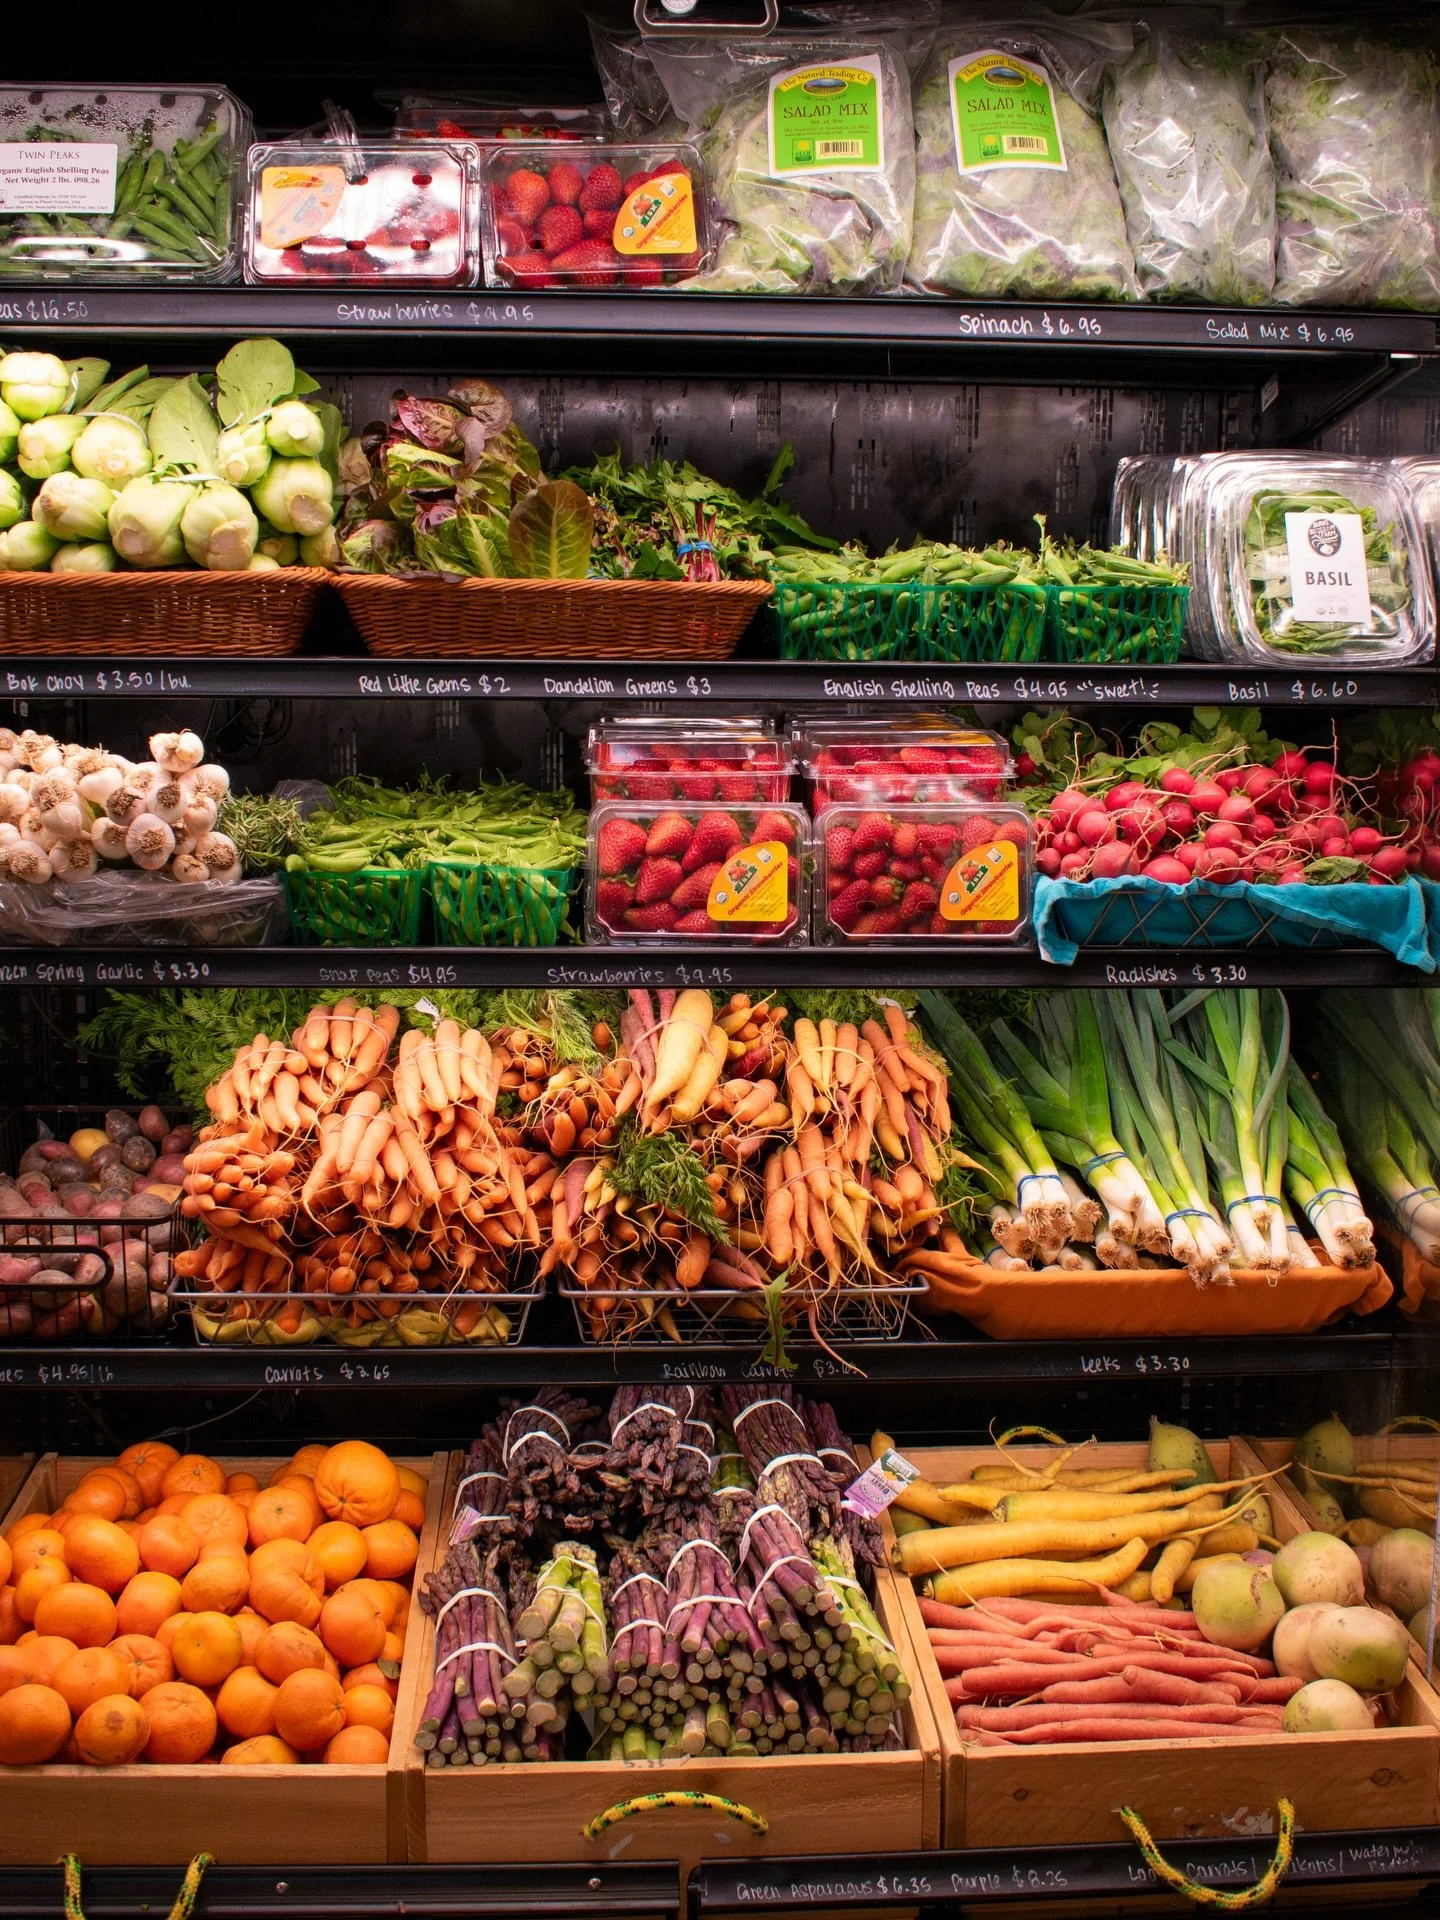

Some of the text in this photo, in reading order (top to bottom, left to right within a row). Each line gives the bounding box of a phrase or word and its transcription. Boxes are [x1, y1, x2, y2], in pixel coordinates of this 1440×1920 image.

[978, 58, 1004, 69] Natural
[784, 69, 868, 88] The Natural Trading Co
[783, 103, 868, 119] SALAD MIX
[967, 97, 1047, 116] SALAD MIX
[18, 150, 80, 160] TWIN PEAKS
[25, 166, 54, 176] English
[57, 166, 89, 176] Shelling
[91, 167, 110, 175] Peas
[21, 177, 49, 185] Weight
[337, 300, 453, 321] Strawberries
[959, 312, 1033, 335] Spinach
[1206, 318, 1250, 340] Salad
[1260, 322, 1291, 340] Mix
[1306, 571, 1352, 586] BASIL
[7, 672, 38, 692] Bok
[46, 674, 84, 692] Choy
[359, 675, 382, 693] Red
[426, 676, 471, 693] Gems
[544, 675, 712, 696] Dandelion Greens $3
[824, 678, 884, 697] English
[890, 678, 955, 698] Shelling
[966, 680, 1000, 698] Peas
[1014, 677, 1068, 698] $4.95
[1228, 682, 1269, 700] Basil
[728, 894, 749, 916] Organic
[749, 862, 783, 894] Strawberries
[960, 894, 982, 915] Organic
[980, 861, 1013, 894] Strawberries
[36, 963, 84, 982] Spring
[96, 963, 143, 980] Garlic
[548, 966, 664, 983] Strawberries
[1106, 964, 1177, 984] Radishes
[265, 1366, 323, 1383] Carrots
[737, 1881, 781, 1900] Green
[791, 1880, 873, 1900] Asparagus
[950, 1873, 1001, 1892] Purple
